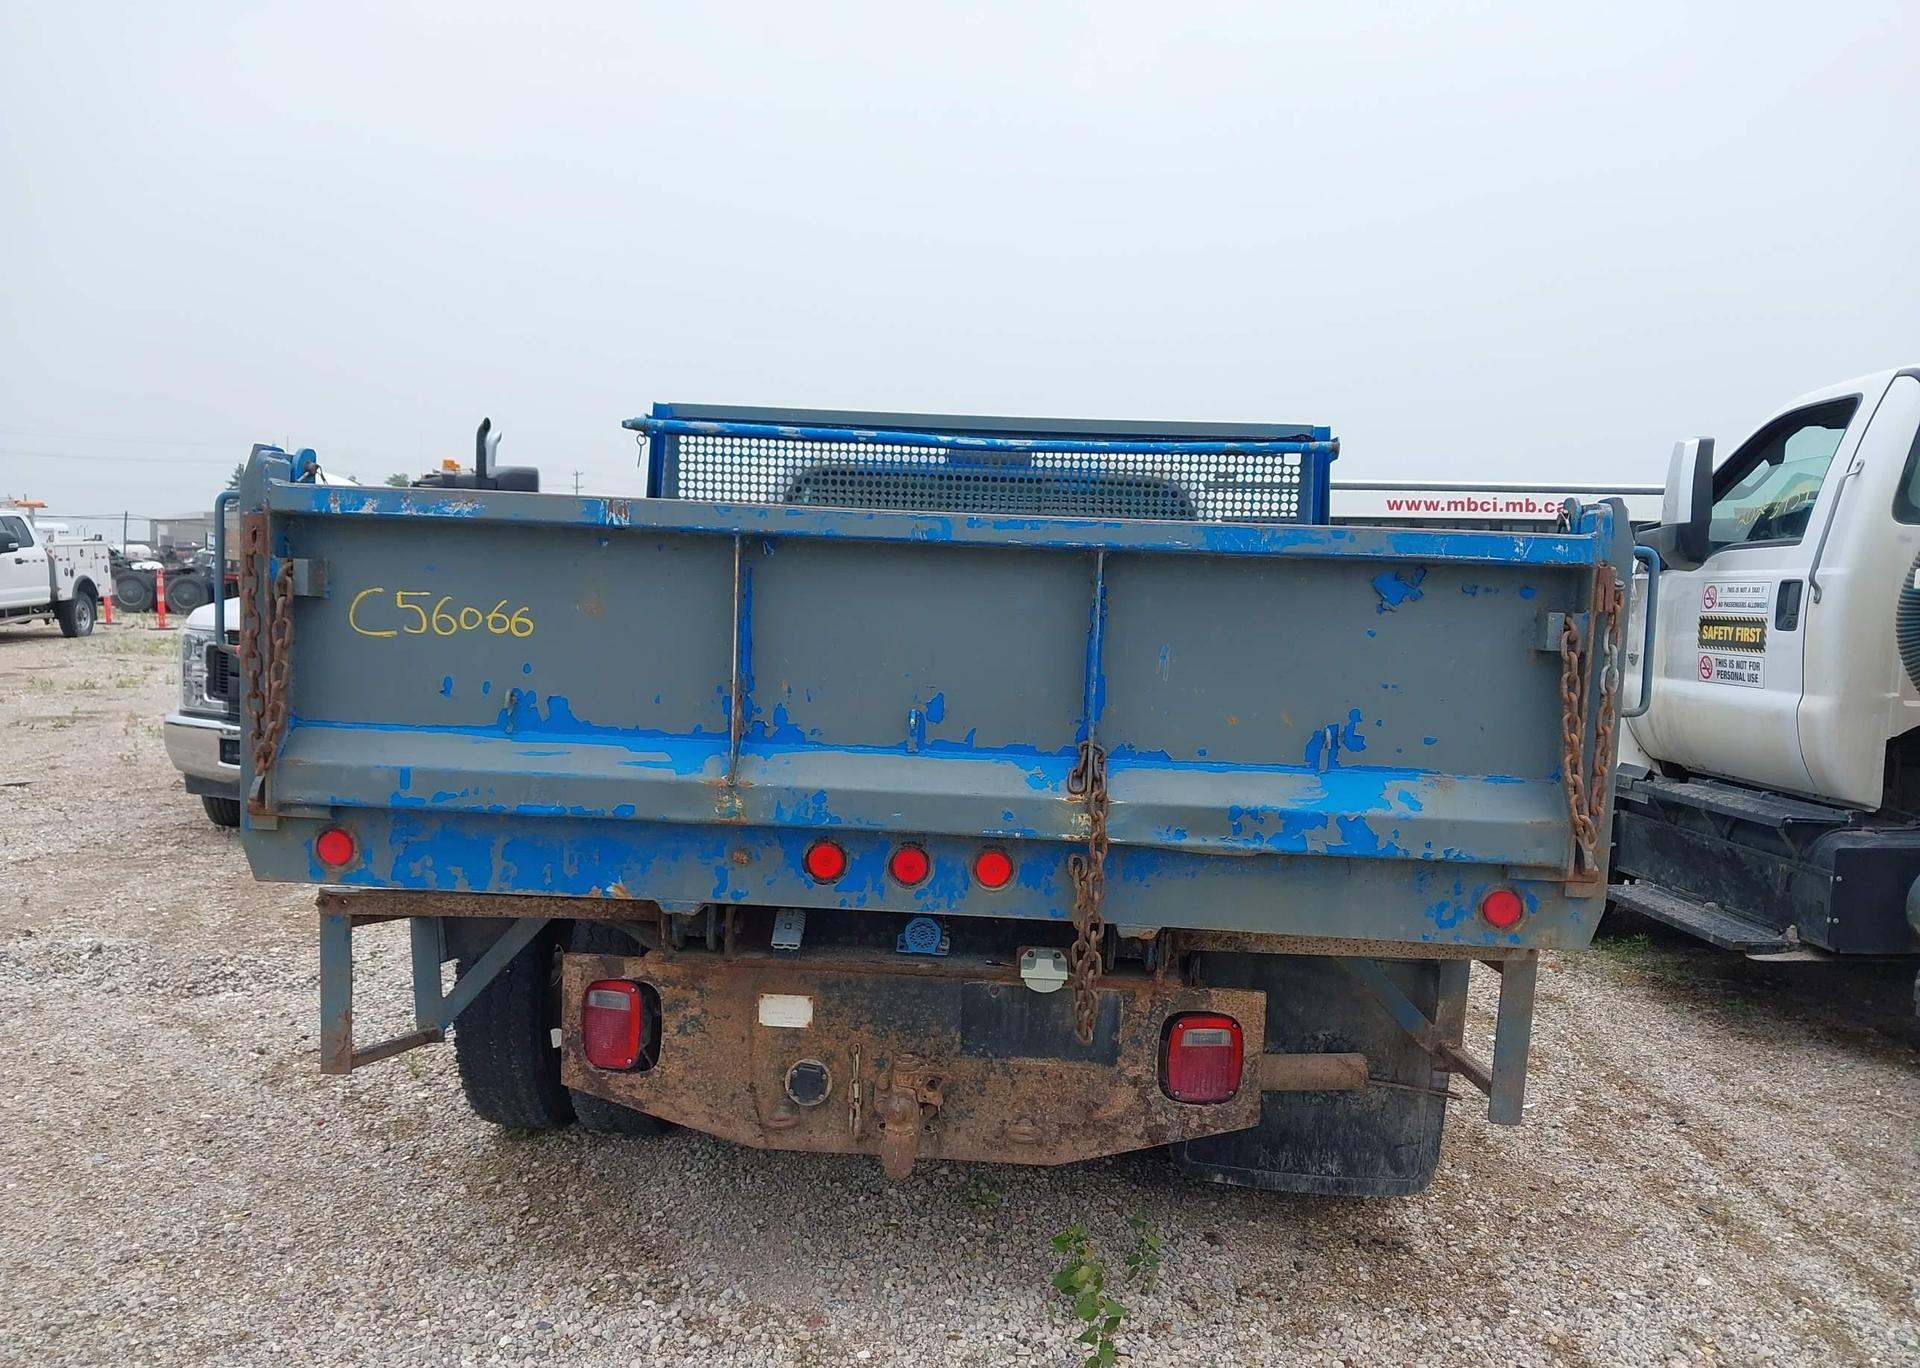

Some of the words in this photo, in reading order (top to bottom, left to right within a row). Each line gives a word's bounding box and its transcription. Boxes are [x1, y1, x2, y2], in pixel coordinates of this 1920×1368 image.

[1386, 496, 1565, 514] www.mbci.mb.ca
[349, 586, 535, 638] C56066
[1702, 625, 1734, 641] SAFETY
[1735, 626, 1762, 643] FIRST
[1715, 658, 1728, 668] THIS
[1728, 659, 1735, 669] IS
[1735, 660, 1748, 670] NOT
[1748, 661, 1761, 672] FOR
[1716, 669, 1746, 682] PERSONAL
[1747, 673, 1759, 683] USE
